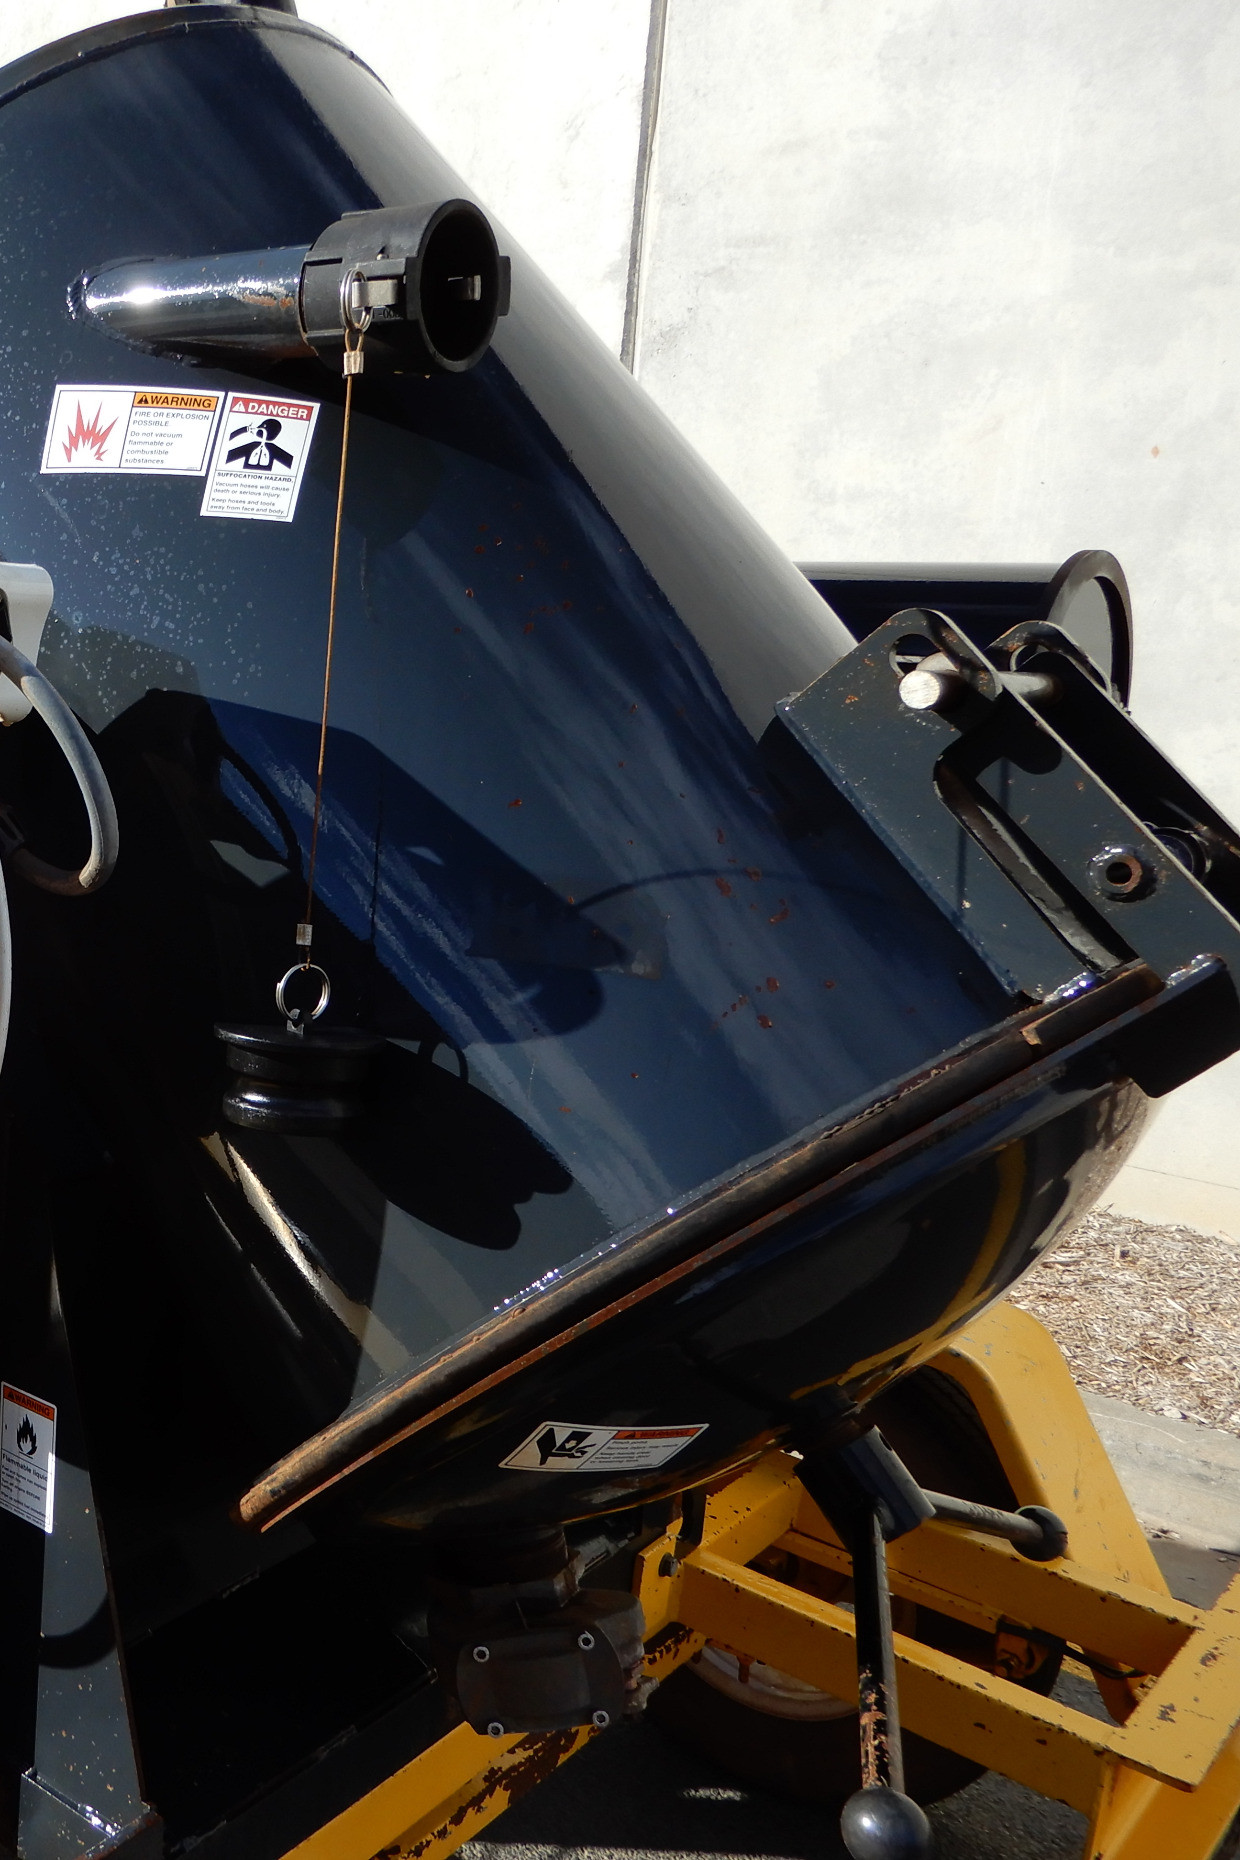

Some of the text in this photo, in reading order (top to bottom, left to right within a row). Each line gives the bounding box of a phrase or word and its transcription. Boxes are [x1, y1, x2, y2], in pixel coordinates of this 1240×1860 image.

[150, 395, 212, 408] WARNING
[165, 412, 210, 420] EXPLOSION
[248, 402, 308, 419] DANGER
[128, 439, 164, 447] flammable
[217, 472, 263, 480] SUFFOCATION
[15, 1393, 50, 1417] WARNING
[2, 1453, 32, 1473] Flammable
